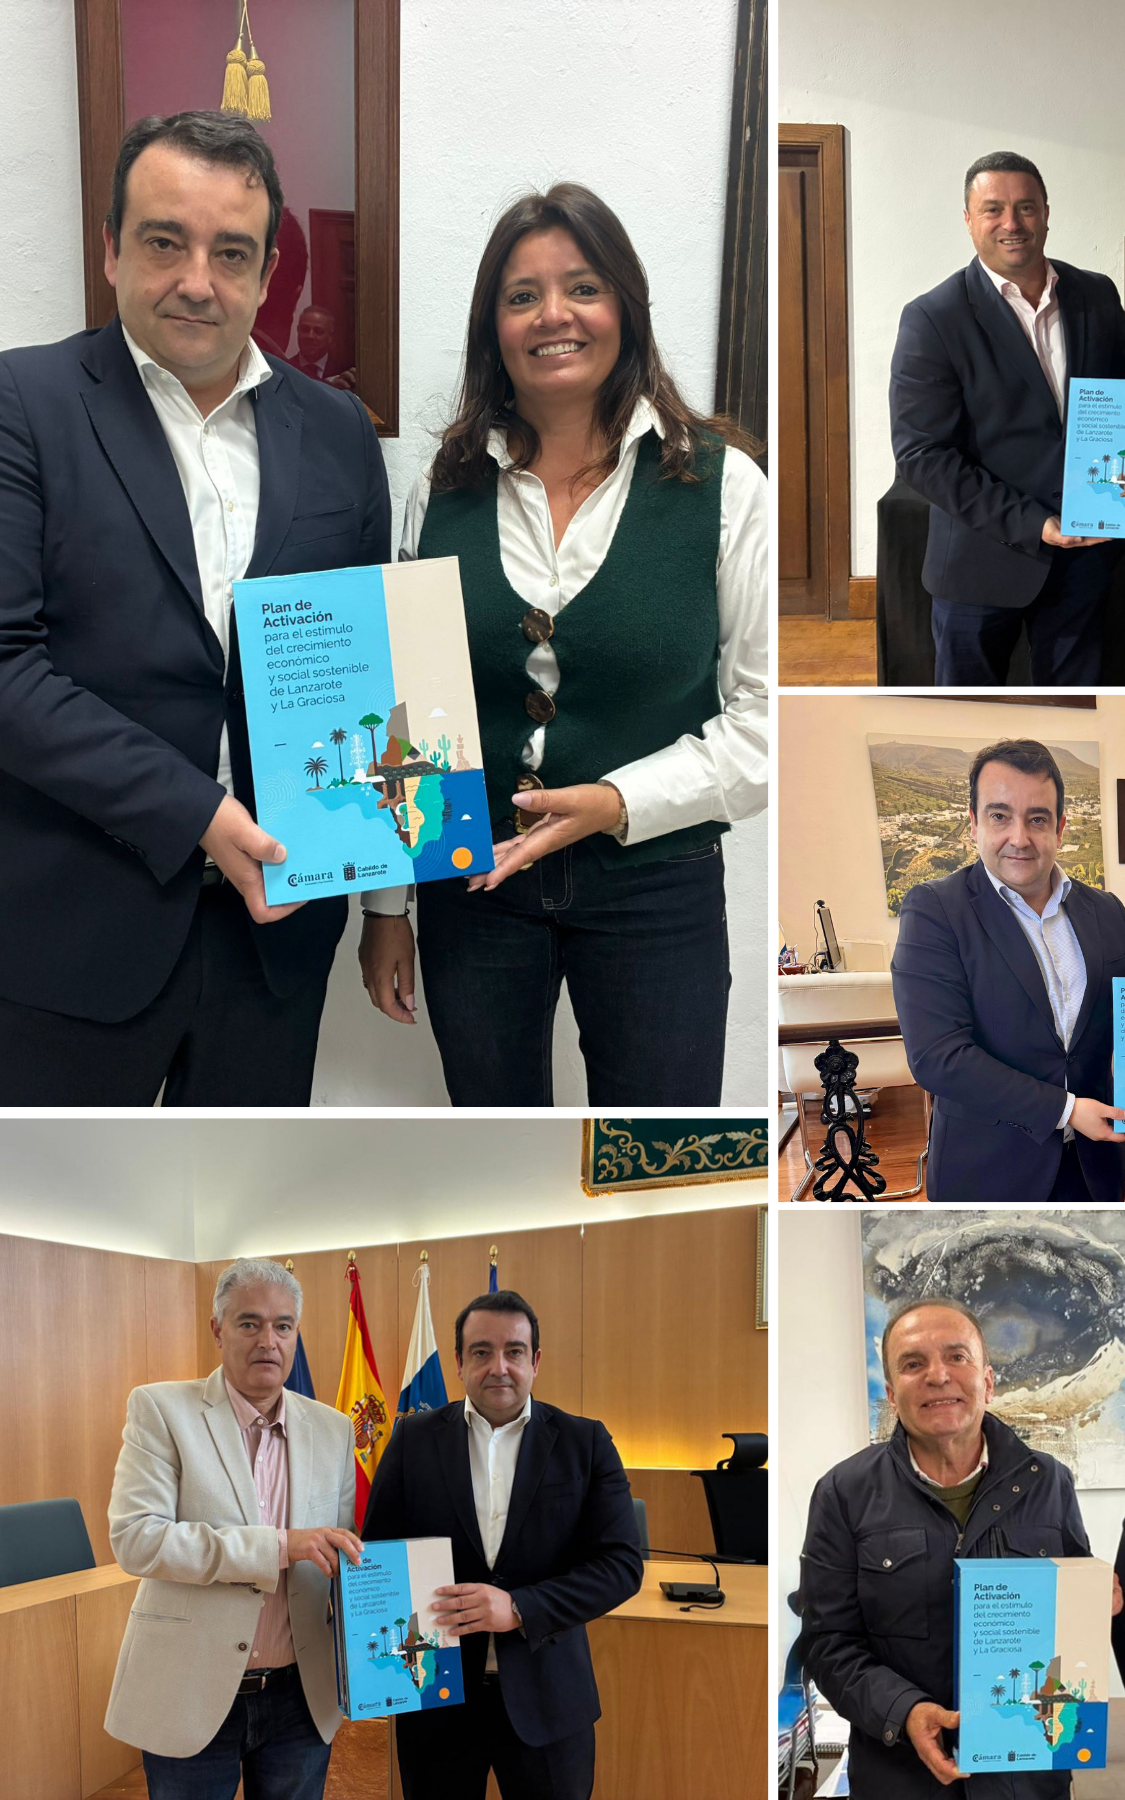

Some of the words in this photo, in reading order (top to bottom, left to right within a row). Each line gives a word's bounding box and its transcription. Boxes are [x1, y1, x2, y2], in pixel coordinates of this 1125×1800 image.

[261, 602, 292, 615] Plan
[294, 599, 313, 611] de
[262, 610, 333, 629] Activación
[264, 631, 290, 645] para
[291, 628, 304, 639] el
[304, 623, 353, 638] estímulo
[265, 643, 285, 656] del
[285, 637, 352, 654] crecimiento
[266, 653, 330, 670] económico
[267, 674, 276, 686] y
[277, 668, 311, 682] social
[312, 662, 369, 678] sostenible
[269, 686, 285, 697] de
[287, 679, 343, 695] Lanzarote
[270, 702, 278, 714] y
[280, 699, 294, 710] La
[296, 693, 345, 707] Graciosa
[356, 864, 380, 873] Cabildo
[357, 869, 387, 878] Lanzarote
[973, 1583, 994, 1592] Plan
[995, 1581, 1008, 1591] de
[973, 1590, 1021, 1601] Activación
[973, 1603, 991, 1612] para
[991, 1601, 1000, 1609] el
[973, 1611, 986, 1619] del
[986, 1609, 1031, 1619] crecimiento
[973, 1631, 979, 1639] y
[979, 1628, 1001, 1637] social
[1002, 1626, 1041, 1636] sostenible
[973, 1638, 984, 1646] de
[984, 1636, 1022, 1645] Lanzarote
[989, 1645, 1022, 1654] Graciosa
